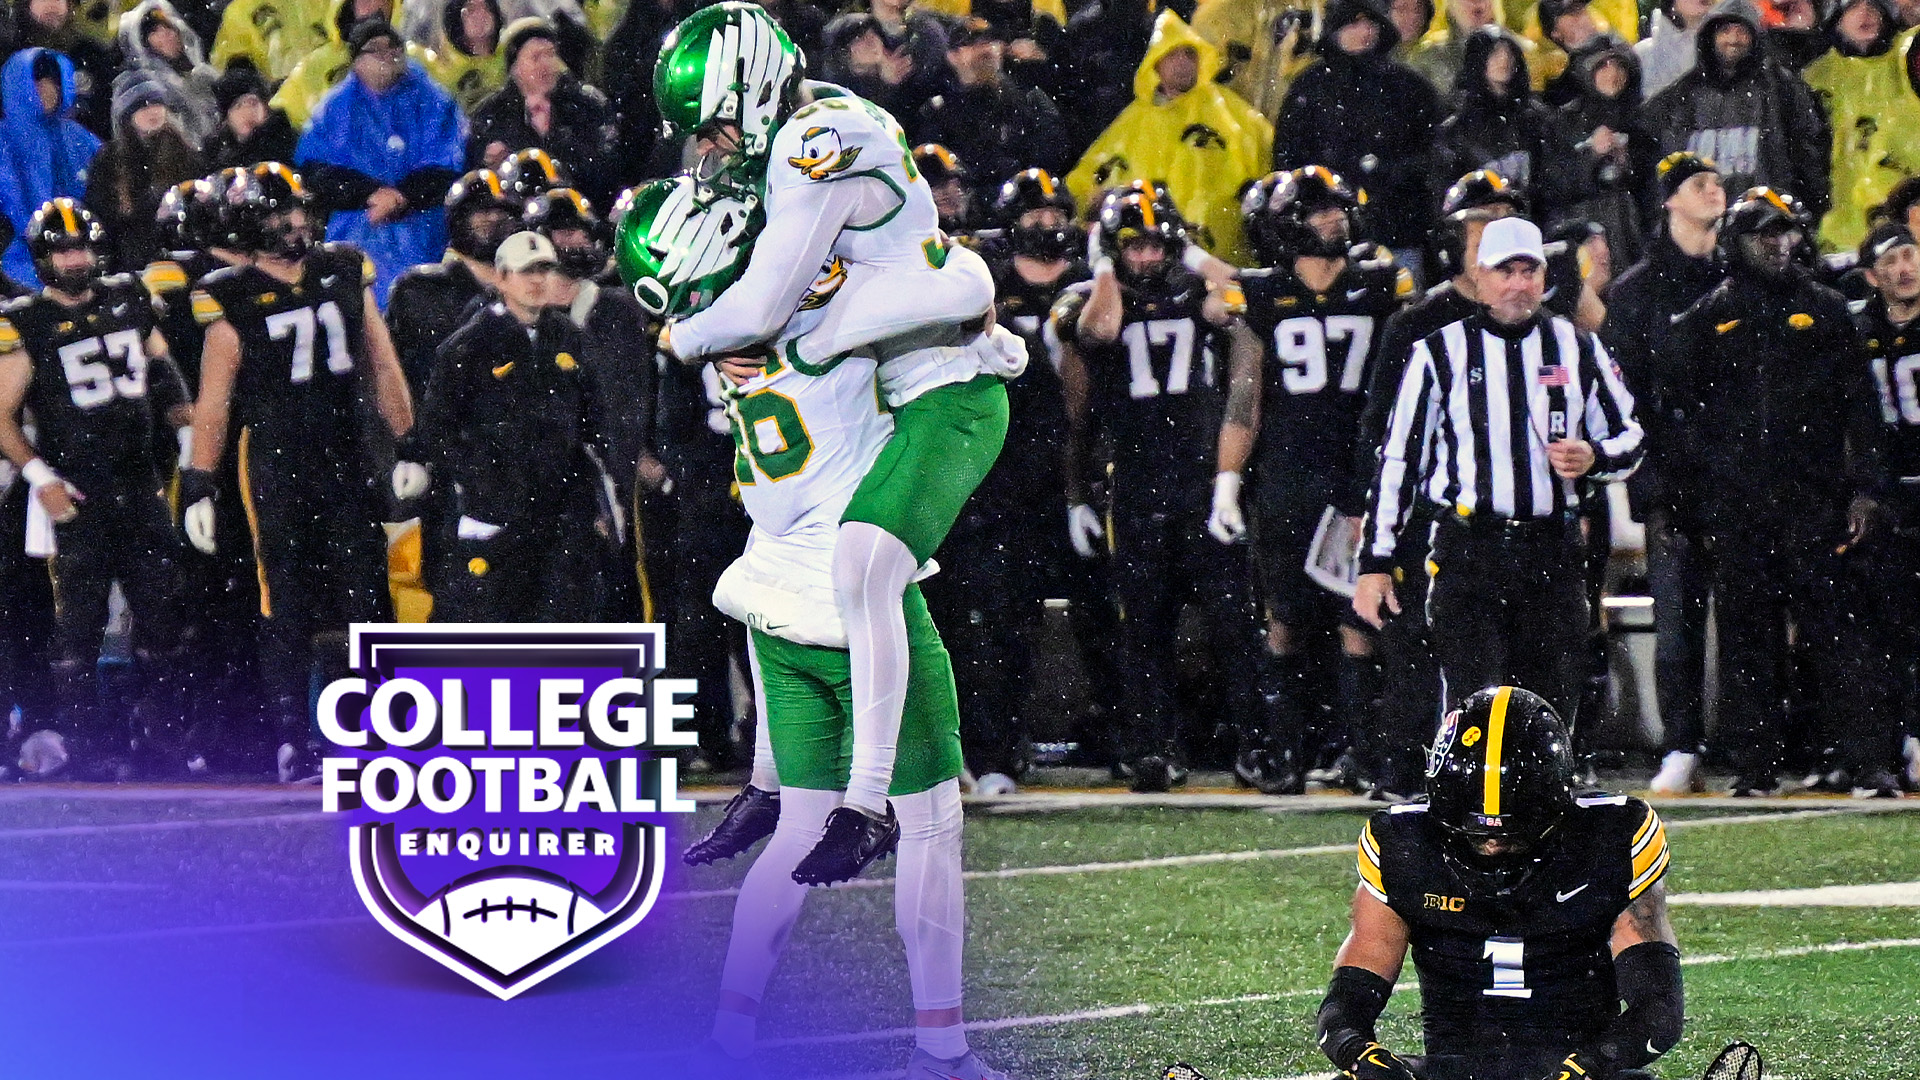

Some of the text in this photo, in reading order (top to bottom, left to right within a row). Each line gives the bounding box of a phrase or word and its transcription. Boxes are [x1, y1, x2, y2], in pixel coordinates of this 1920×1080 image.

[58, 328, 148, 409] 53
[265, 300, 353, 384] 71
[1121, 316, 1198, 399] 17
[1273, 315, 1375, 396] 97
[1550, 411, 1567, 435] R
[1482, 936, 1532, 999] 1
